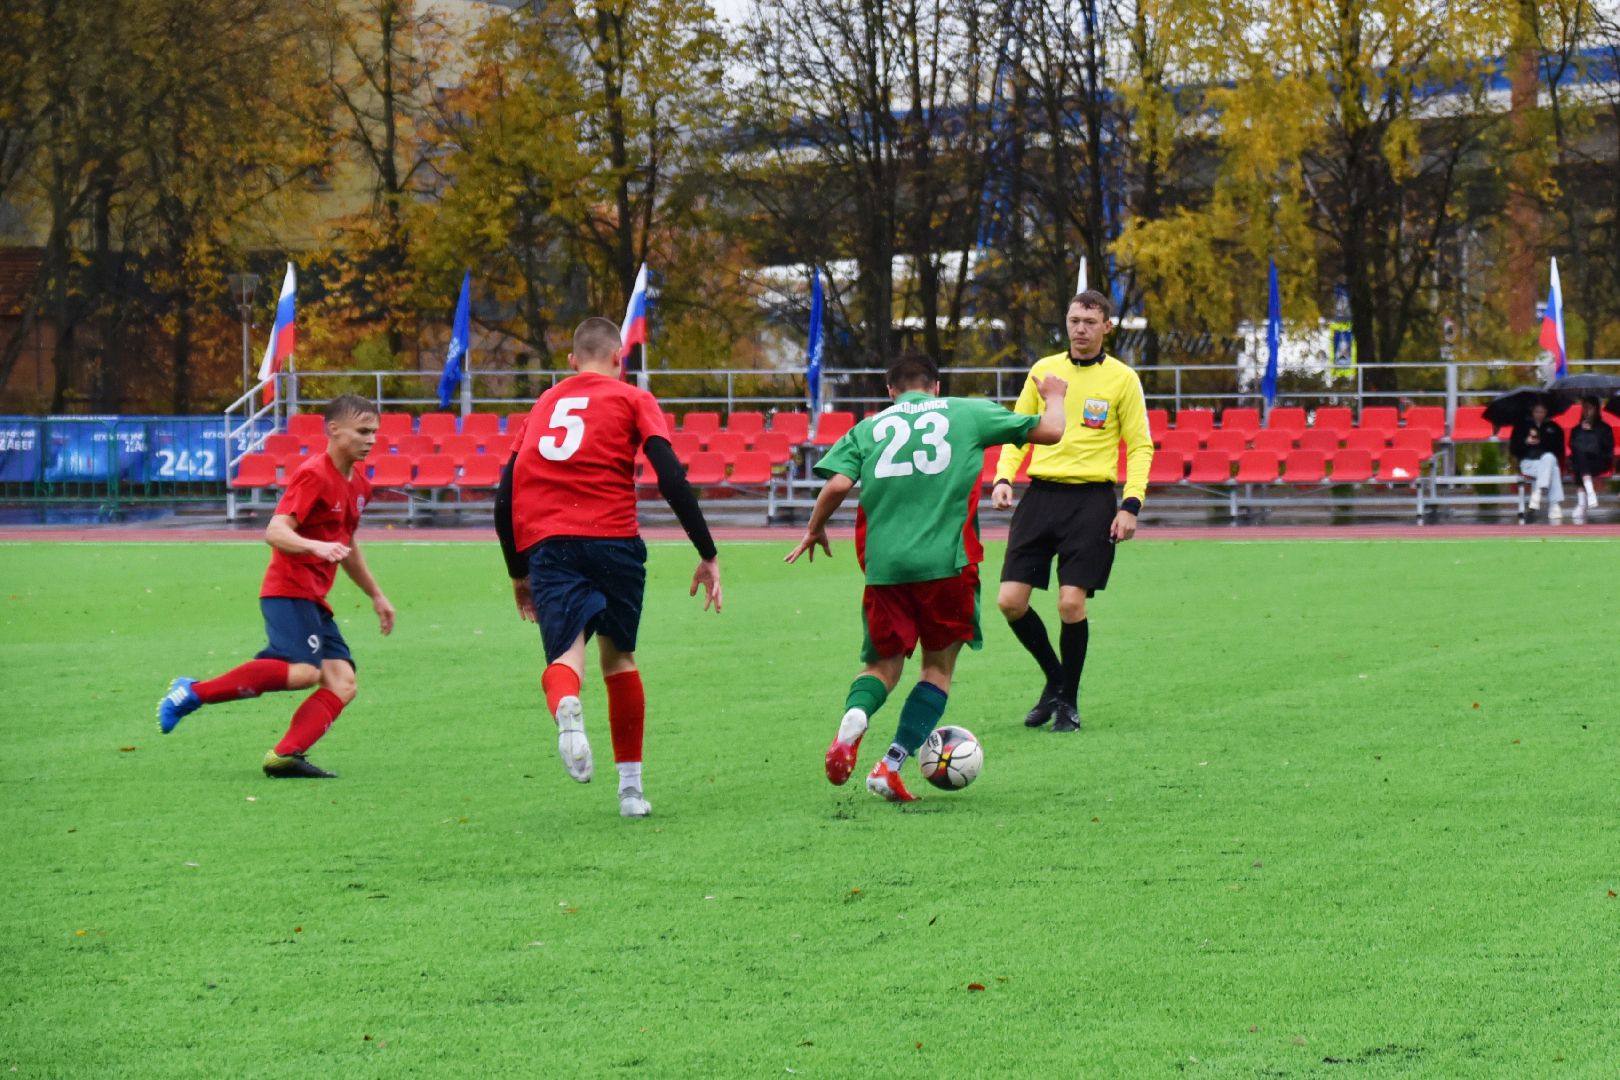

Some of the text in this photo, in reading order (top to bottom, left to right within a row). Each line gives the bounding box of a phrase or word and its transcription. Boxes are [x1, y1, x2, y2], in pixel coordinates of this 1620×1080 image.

[538, 396, 590, 461] 5
[873, 412, 952, 479] 23
[156, 449, 215, 476] 242
[307, 634, 320, 654] 9
